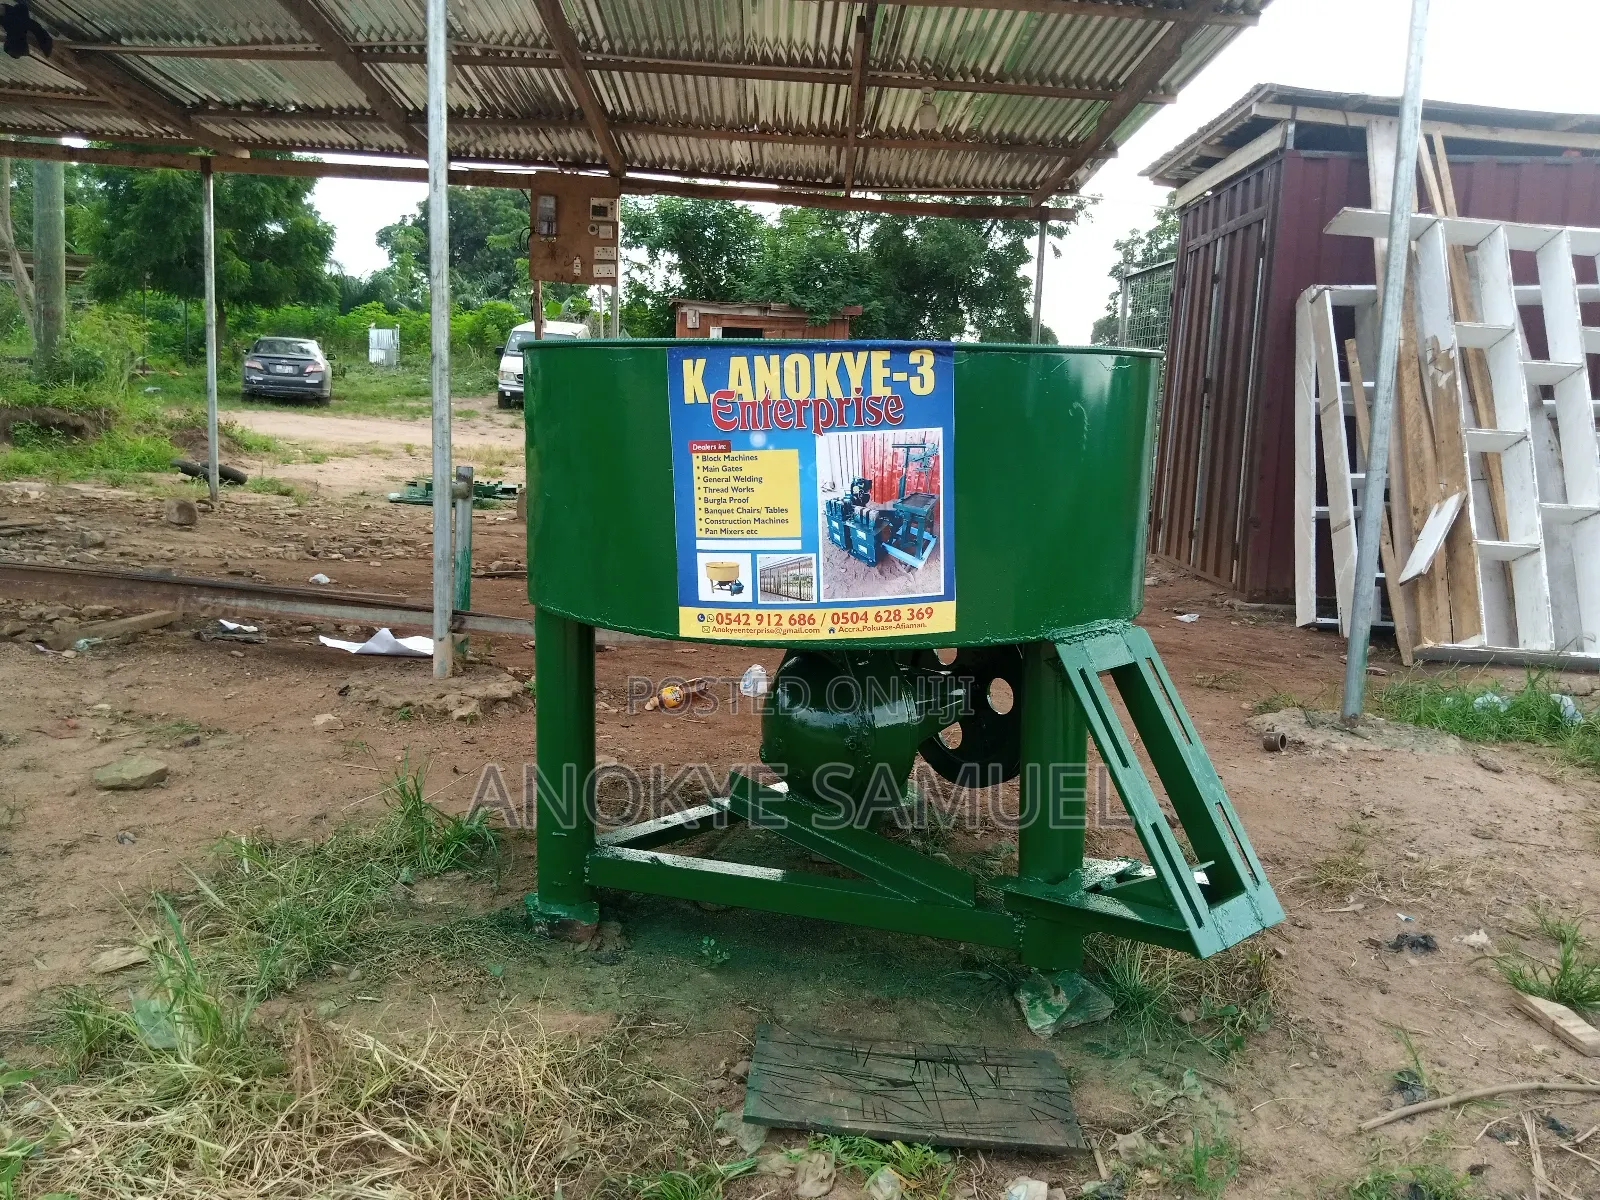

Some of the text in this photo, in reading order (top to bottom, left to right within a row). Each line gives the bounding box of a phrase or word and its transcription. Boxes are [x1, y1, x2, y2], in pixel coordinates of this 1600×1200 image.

[710, 387, 904, 436] Enterprise
[692, 443, 717, 451] Dealers
[701, 454, 758, 462] Block Machines
[702, 465, 720, 473] Main
[702, 475, 763, 484] General Welding
[731, 485, 755, 493] Works
[703, 496, 750, 505] Burgla Proof
[704, 507, 735, 516] Banquet
[764, 506, 789, 514] Tables
[704, 517, 752, 525] Construction
[719, 527, 745, 535] Mixers
[715, 606, 934, 627] 0542 912 686 / 0504 628 369
[711, 626, 820, 635] Anokyeenterprise@gmail.com
